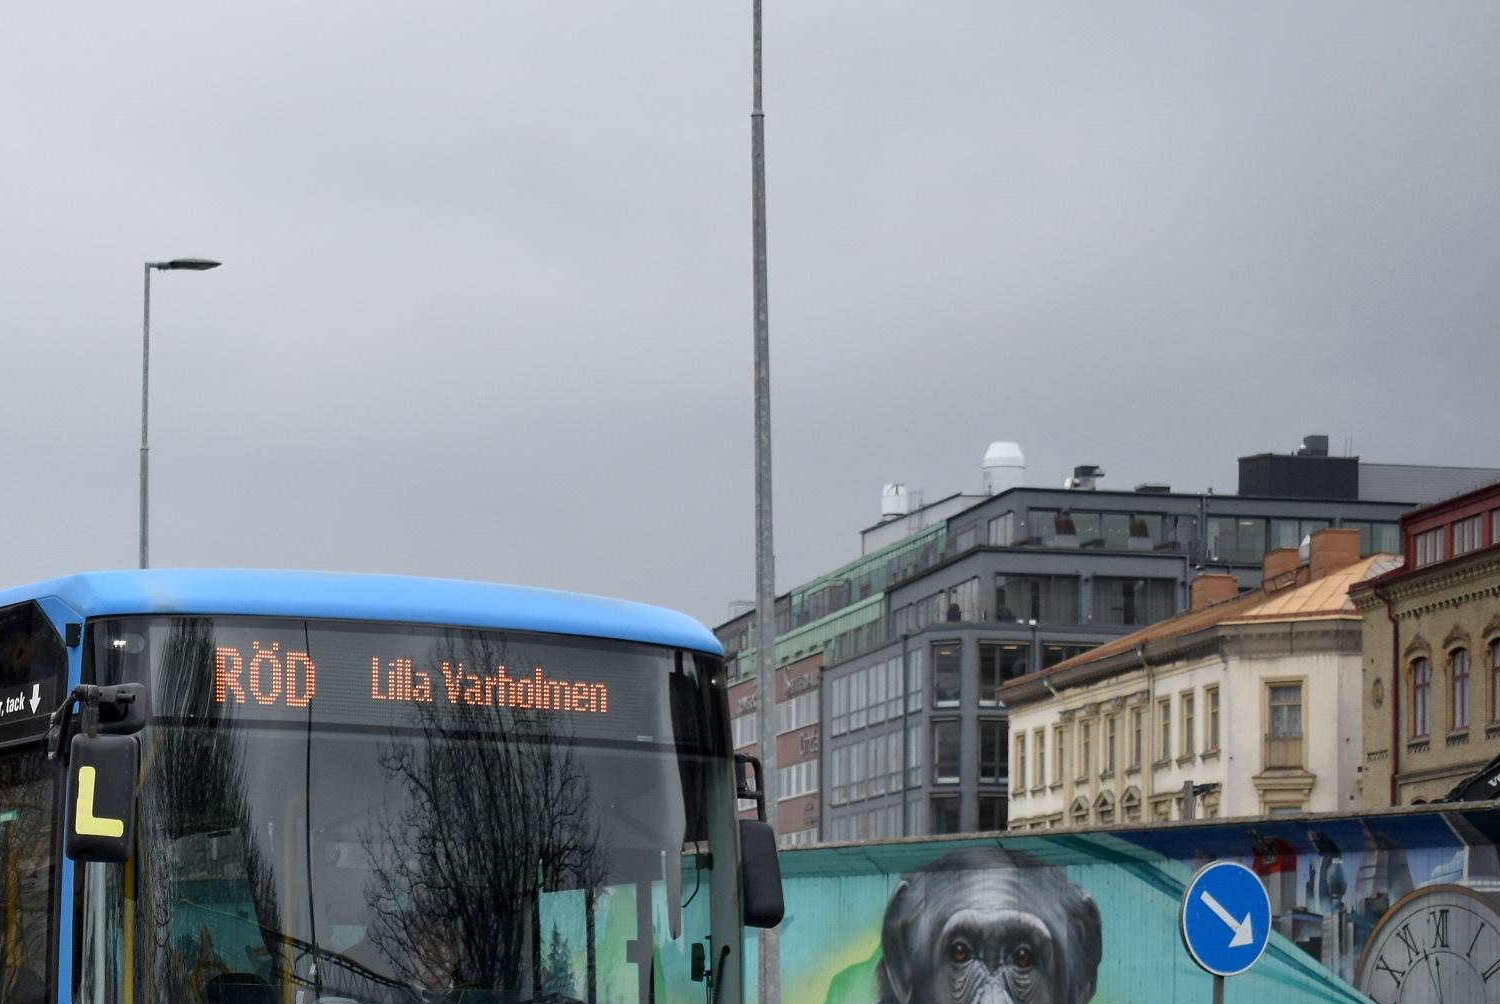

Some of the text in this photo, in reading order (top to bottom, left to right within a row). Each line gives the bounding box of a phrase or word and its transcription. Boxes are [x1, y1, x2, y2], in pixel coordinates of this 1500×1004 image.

[215, 640, 609, 714] RÖD Lilla Varholmen
[6, 691, 26, 713] tack
